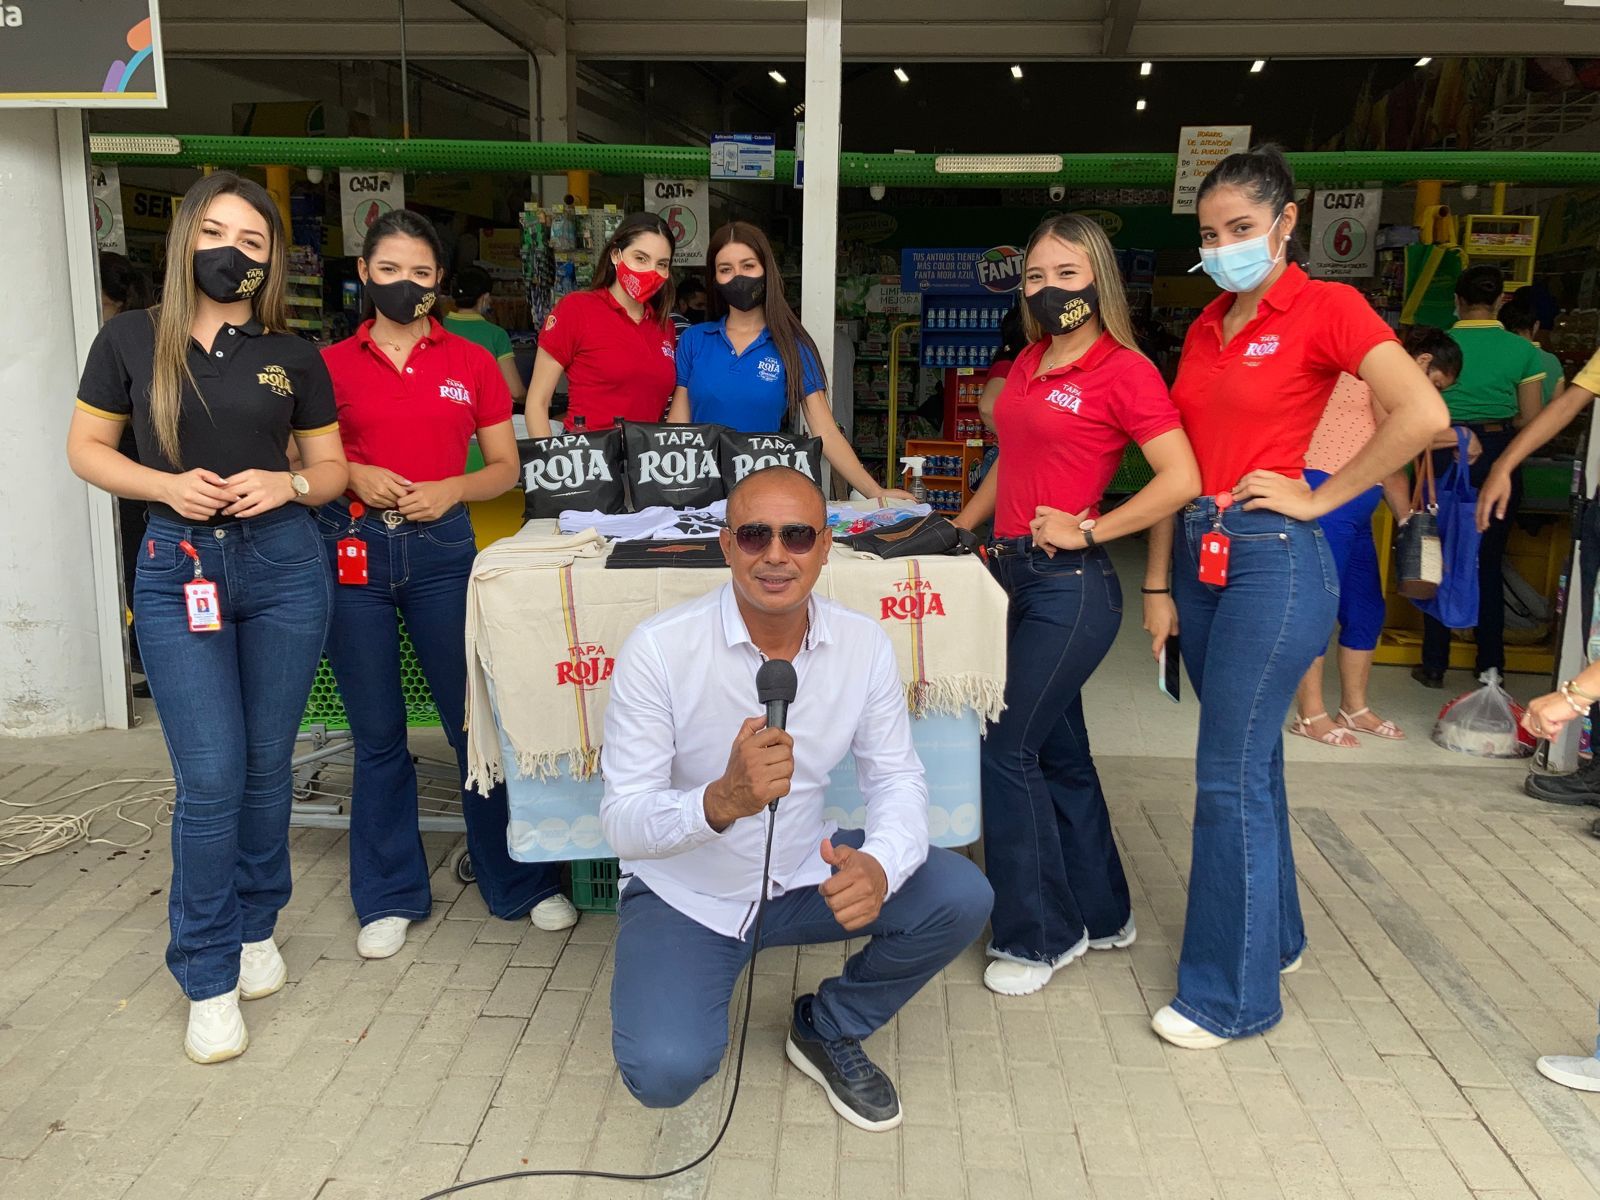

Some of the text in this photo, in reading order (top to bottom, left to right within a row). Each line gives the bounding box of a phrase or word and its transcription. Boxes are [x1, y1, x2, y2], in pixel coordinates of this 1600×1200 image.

[1323, 192, 1366, 210] CAJA
[1333, 220, 1353, 256] 6
[912, 252, 981, 261] TUS ANTOJOS TIENEN
[246, 270, 264, 278] TAPA
[932, 262, 955, 271] COLOR
[957, 262, 972, 271] CON
[978, 255, 1025, 283] FANT
[914, 271, 974, 280] FANTA MORA AZUL
[880, 296, 920, 305] MEJORA
[1064, 298, 1085, 310] TAPA
[1058, 302, 1091, 328] ROJA
[1243, 341, 1280, 357] ROJA
[757, 360, 780, 373] ROJA
[256, 373, 294, 395] ROJA
[1062, 383, 1082, 396] TAPA
[438, 385, 472, 405] ROJA
[1045, 389, 1082, 414] ROJA
[535, 433, 590, 452] TAPA
[655, 431, 705, 447] TAPA
[749, 437, 796, 451] TAPA
[522, 448, 614, 494] ROJA
[637, 447, 722, 485] ROJA
[893, 580, 932, 593] TAPA
[879, 592, 946, 621] ROJA
[568, 645, 605, 656] TAPA
[555, 657, 615, 686] ROJA
